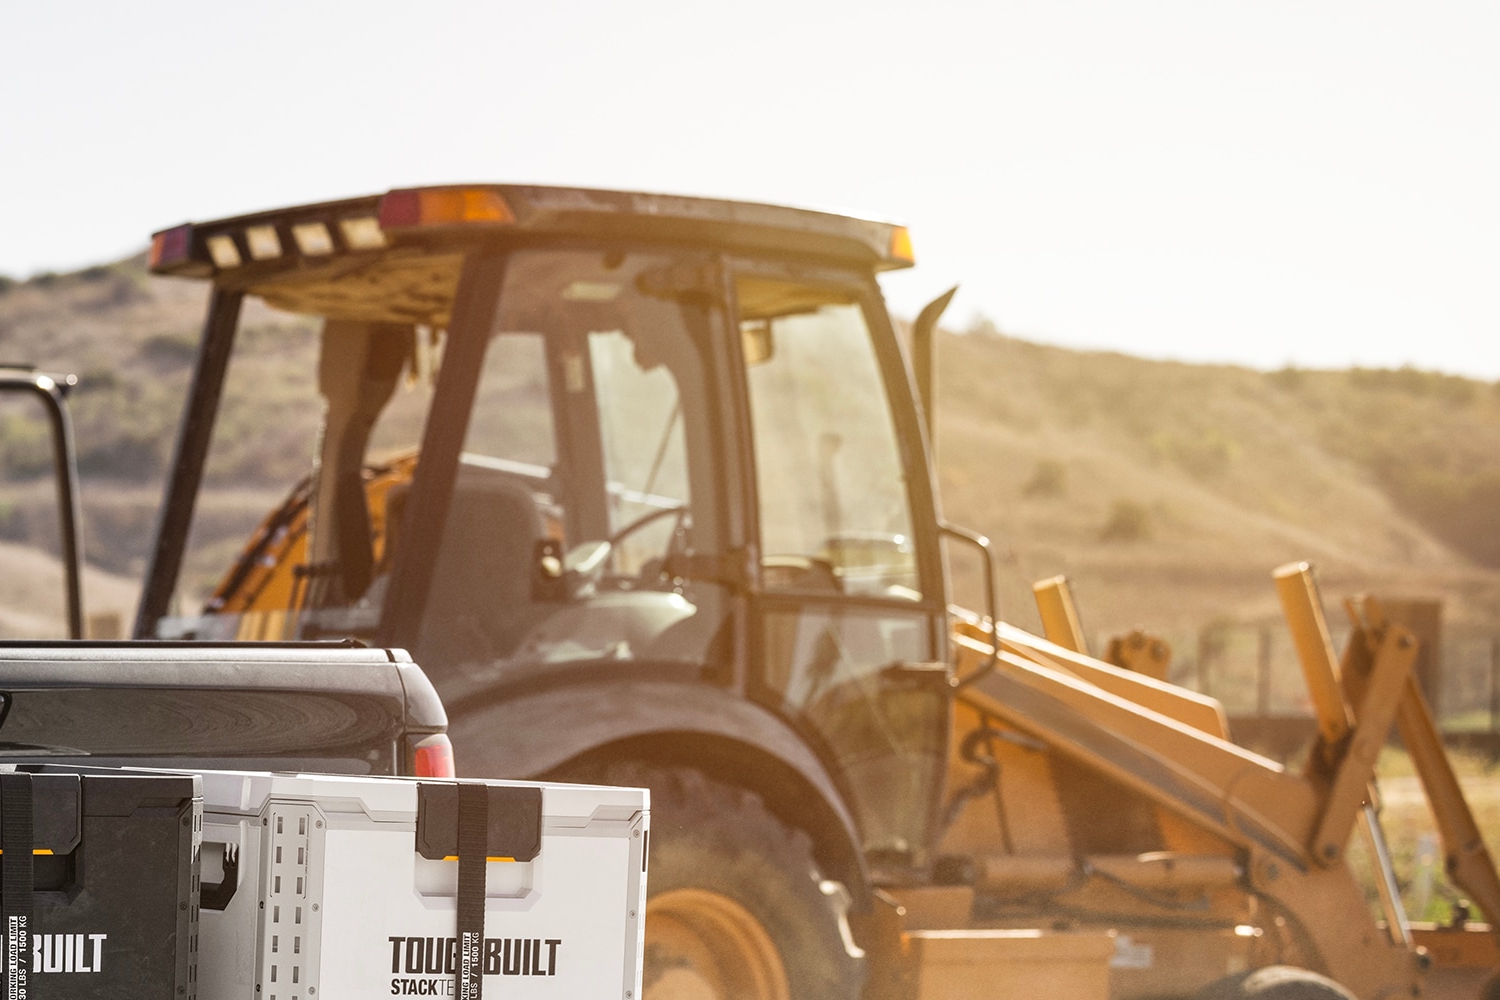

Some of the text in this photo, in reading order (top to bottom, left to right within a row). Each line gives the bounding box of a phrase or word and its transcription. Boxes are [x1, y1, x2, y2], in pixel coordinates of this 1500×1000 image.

[9, 918, 18, 942] LIMIT
[19, 915, 27, 928] KG
[19, 930, 27, 953] 1500
[463, 934, 471, 956] LIMIT
[472, 932, 480, 944] KG
[9, 944, 18, 968] LOAD
[388, 936, 562, 976] TOUGBUILT
[19, 968, 27, 987] LBS
[462, 958, 470, 980] LOAD
[391, 978, 454, 996] STACKTE
[470, 982, 478, 999] LBS
